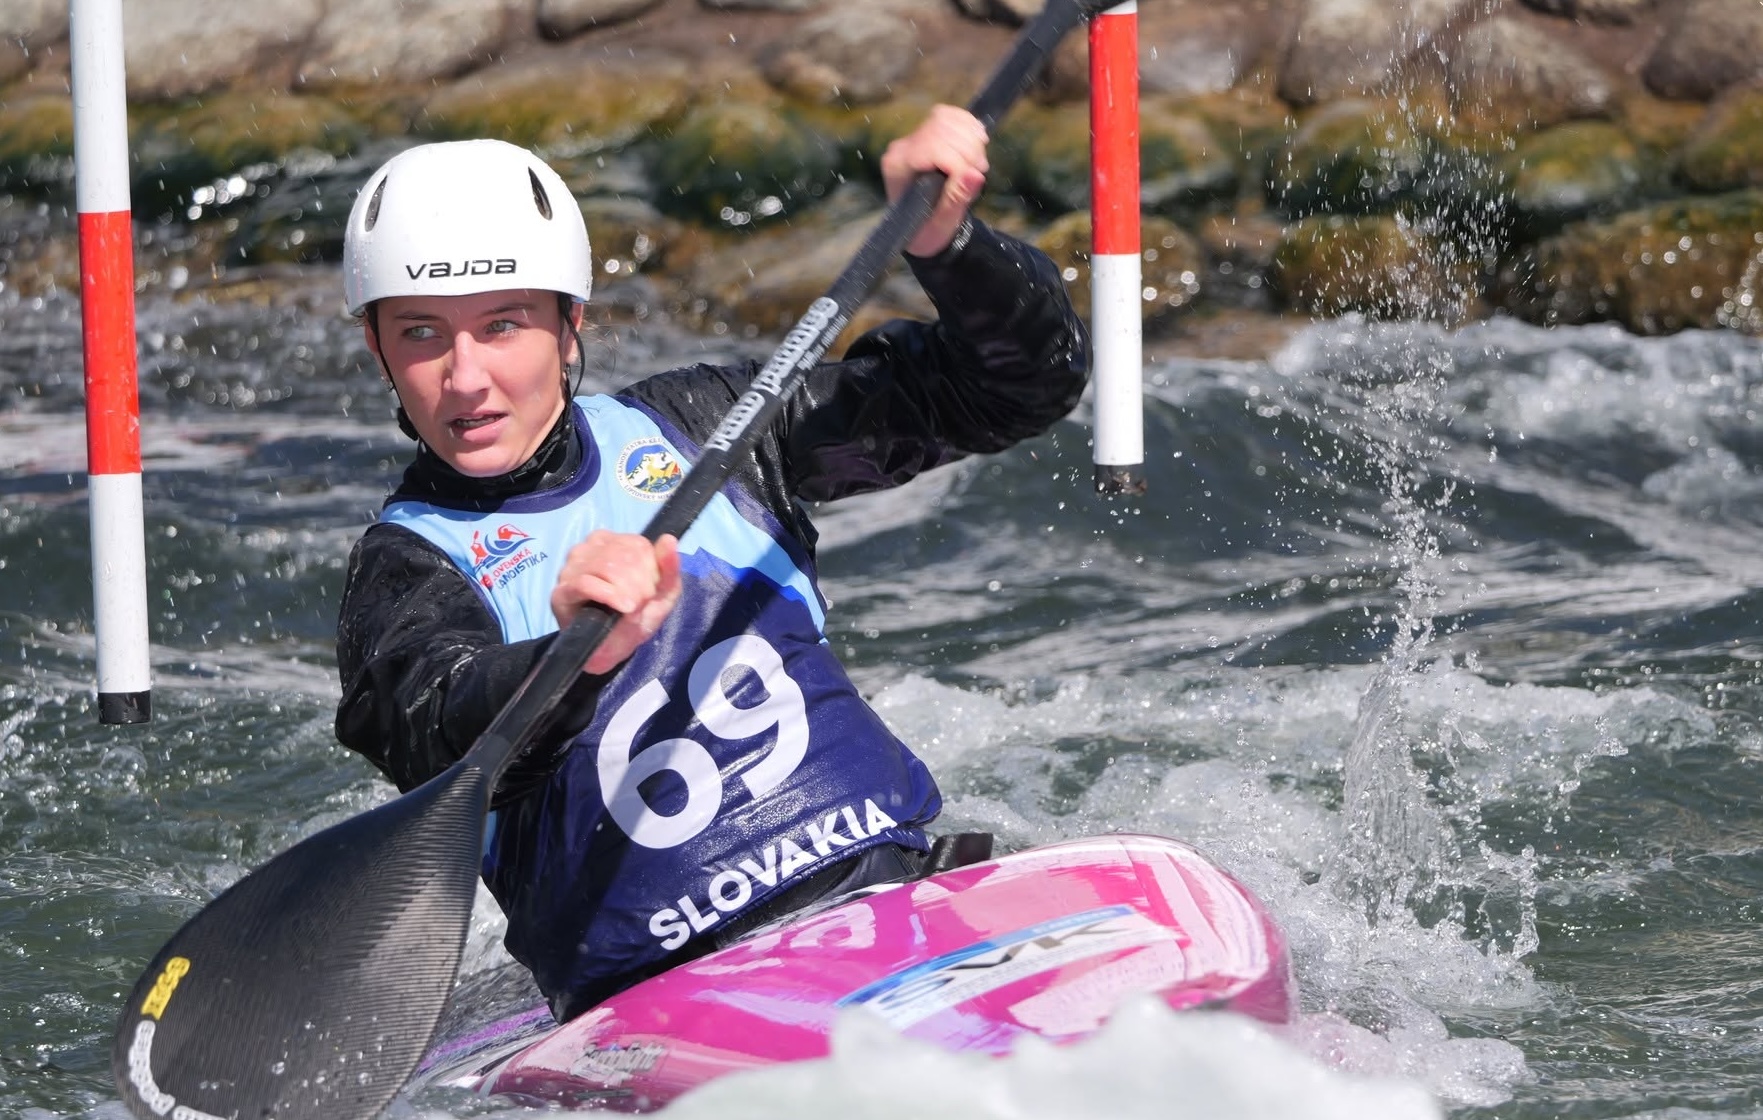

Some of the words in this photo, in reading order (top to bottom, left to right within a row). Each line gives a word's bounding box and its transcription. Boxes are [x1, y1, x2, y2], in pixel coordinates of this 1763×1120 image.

[494, 551, 549, 590] ANOISTIKA
[597, 634, 810, 849] 69
[648, 798, 898, 951] SLOVAKIA
